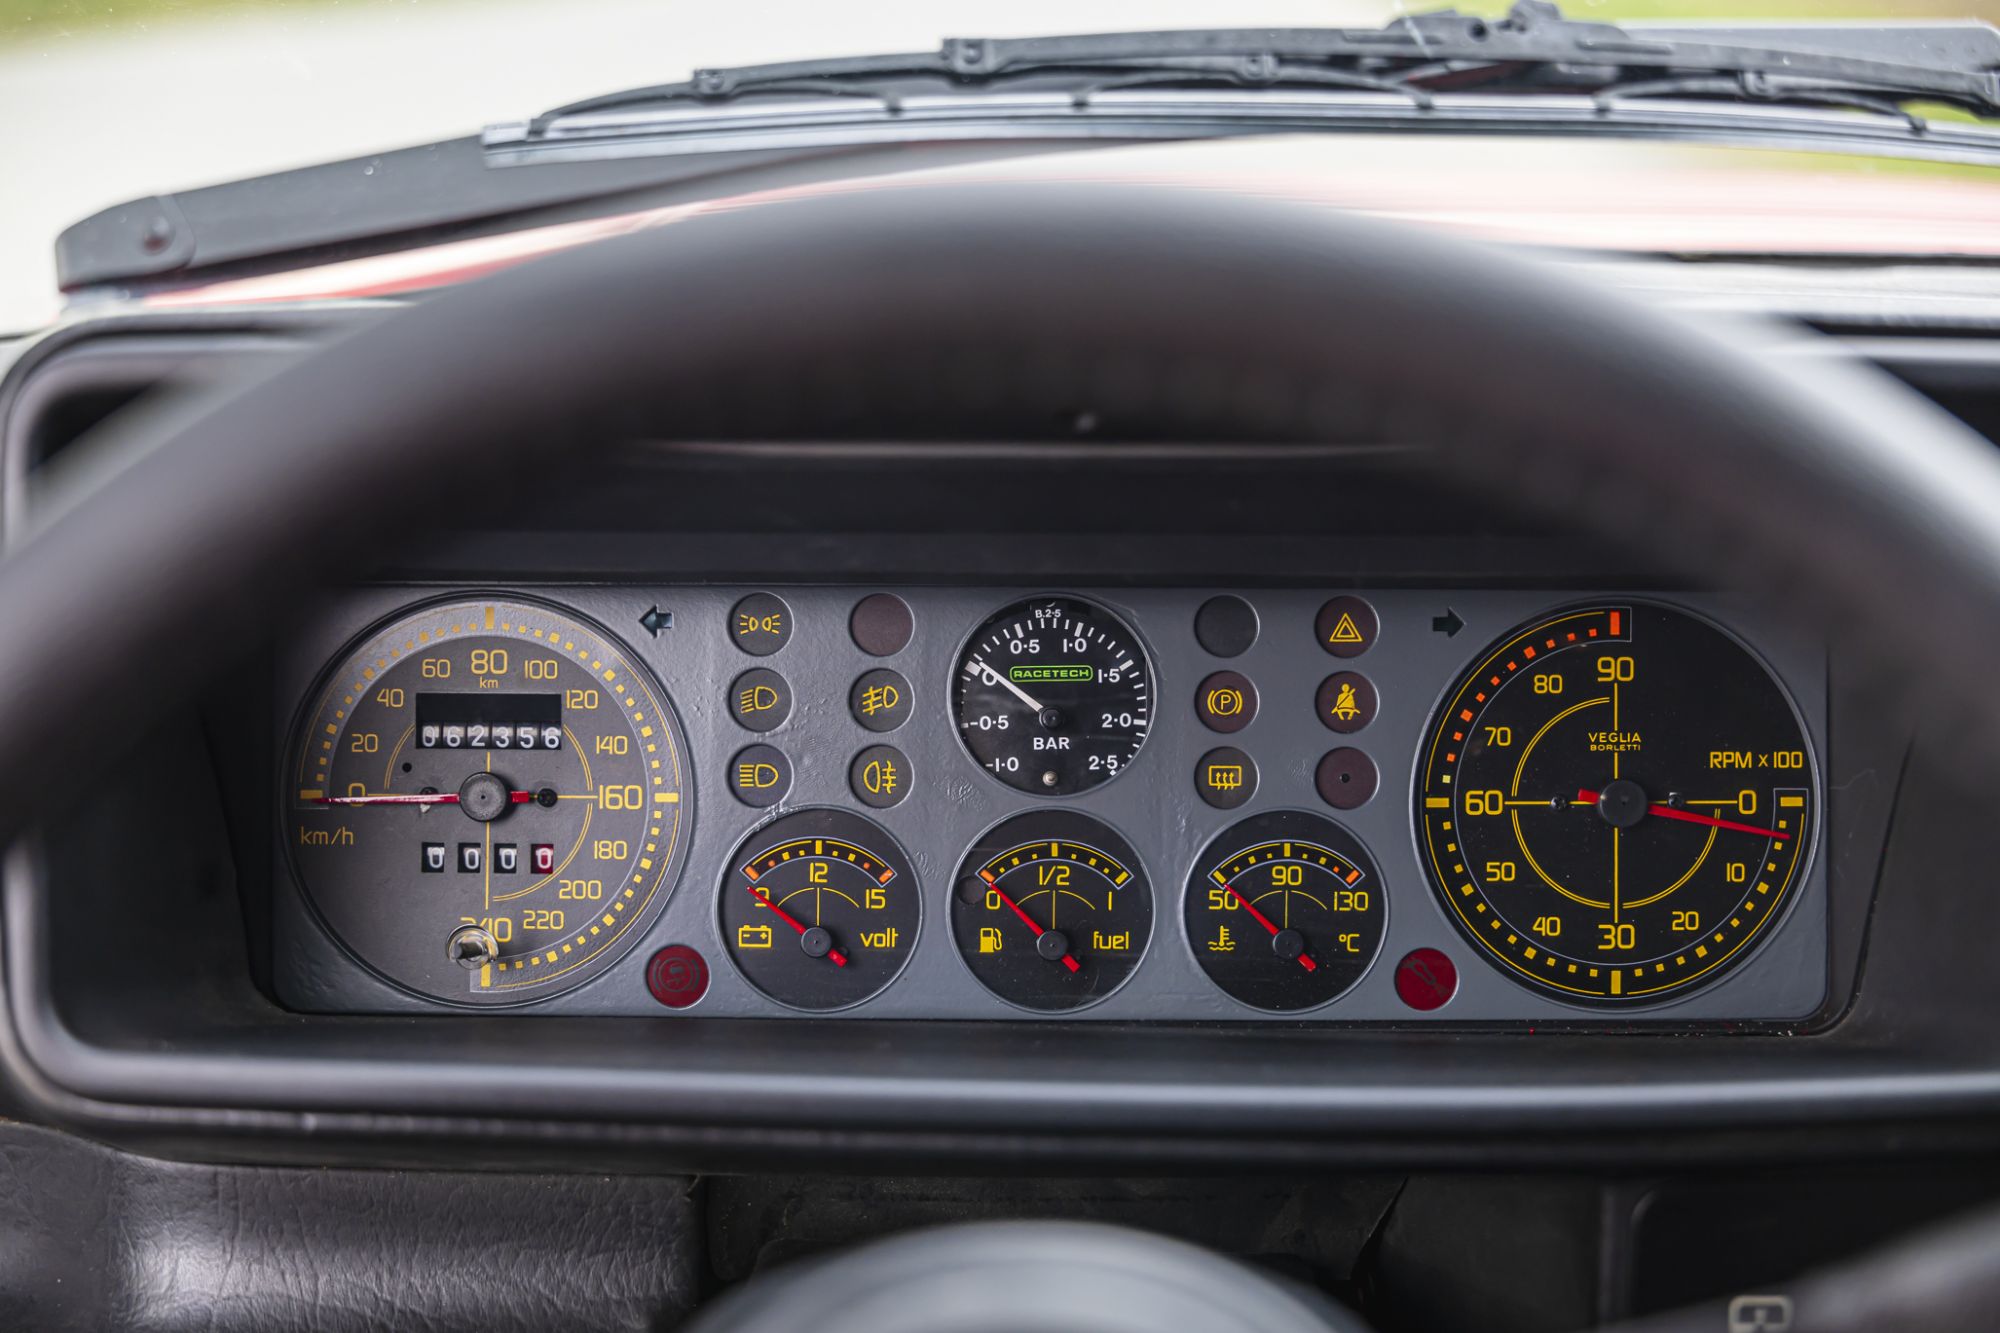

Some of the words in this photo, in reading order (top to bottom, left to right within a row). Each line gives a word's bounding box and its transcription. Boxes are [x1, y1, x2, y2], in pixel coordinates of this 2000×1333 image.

[422, 659, 451, 678] 60
[471, 649, 507, 675] 80
[524, 660, 558, 679] 100
[1597, 657, 1634, 682] 90
[480, 677, 498, 688] km
[1014, 669, 1089, 678] RACETECH
[1534, 675, 1562, 694] 80
[377, 689, 404, 708] 40
[566, 690, 598, 709] 120
[352, 734, 378, 753] 20
[423, 725, 559, 748] 062356
[596, 736, 628, 755] 140
[1033, 737, 1070, 750] BAR
[1485, 727, 1511, 746] 70
[1589, 732, 1641, 742] VEGLIA
[1710, 752, 1752, 768] RPM
[1774, 752, 1803, 768] 100
[348, 783, 366, 807] 0
[599, 785, 642, 809] 160
[1465, 790, 1503, 815] 60
[1738, 790, 1756, 814] 0
[301, 826, 354, 845] km/h
[594, 841, 627, 860] 180
[810, 863, 828, 883] 12
[1039, 866, 1070, 886] 1/2
[1272, 866, 1302, 886] 90
[1486, 862, 1515, 882] 50
[1726, 863, 1745, 882] 10
[559, 880, 601, 899] 200
[866, 889, 885, 909] 15
[986, 890, 1001, 910] 0
[1108, 891, 1112, 911] 1
[1208, 890, 1239, 910] 50
[1334, 892, 1368, 911] 130
[523, 910, 564, 930] 220
[1532, 917, 1561, 936] 40
[1672, 912, 1699, 931] 20
[860, 927, 898, 947] volt
[1093, 931, 1130, 950] fuel
[1338, 934, 1360, 952] °C
[1598, 924, 1635, 950] 30
